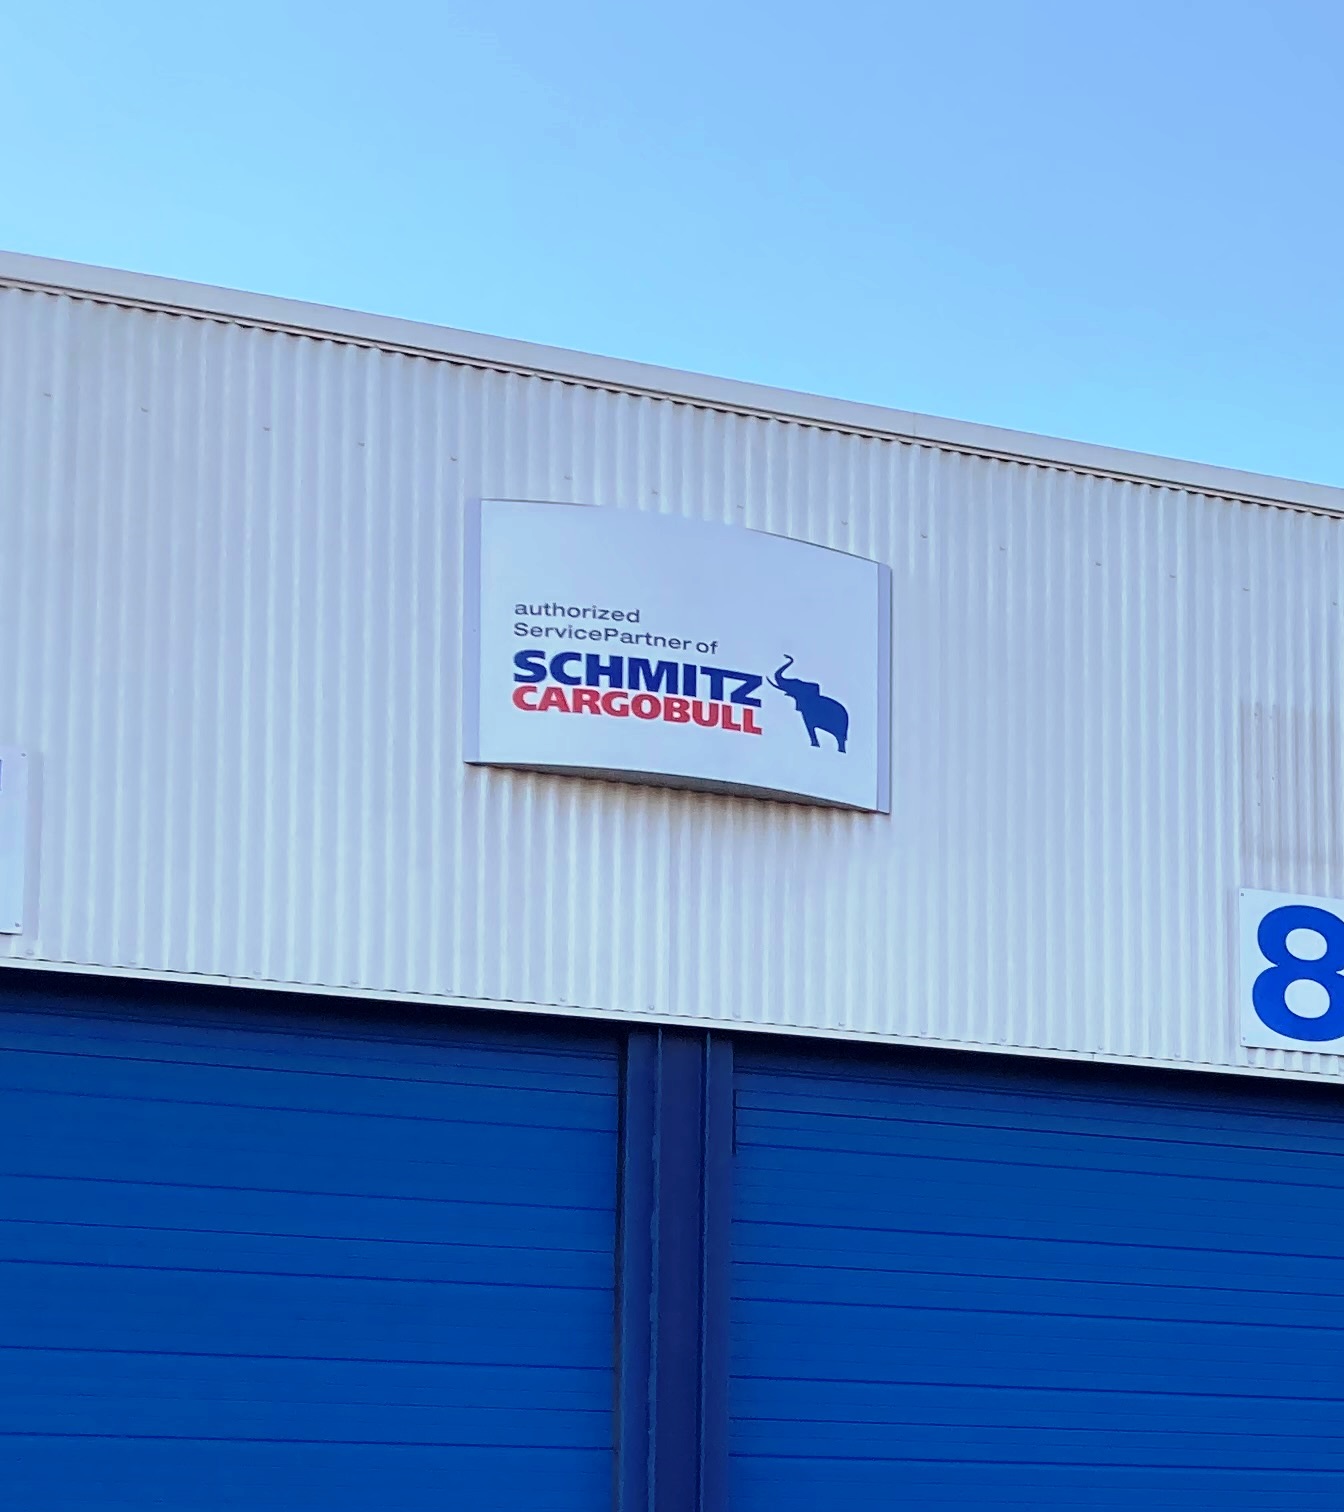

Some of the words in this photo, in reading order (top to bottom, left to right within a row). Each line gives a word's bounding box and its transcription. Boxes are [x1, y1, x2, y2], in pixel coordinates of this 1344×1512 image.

[514, 602, 640, 624] authorized
[513, 622, 690, 651] ServicePartner
[696, 640, 718, 655] of
[512, 649, 763, 708] SCHMITZ
[512, 685, 763, 735] CARGOBULL
